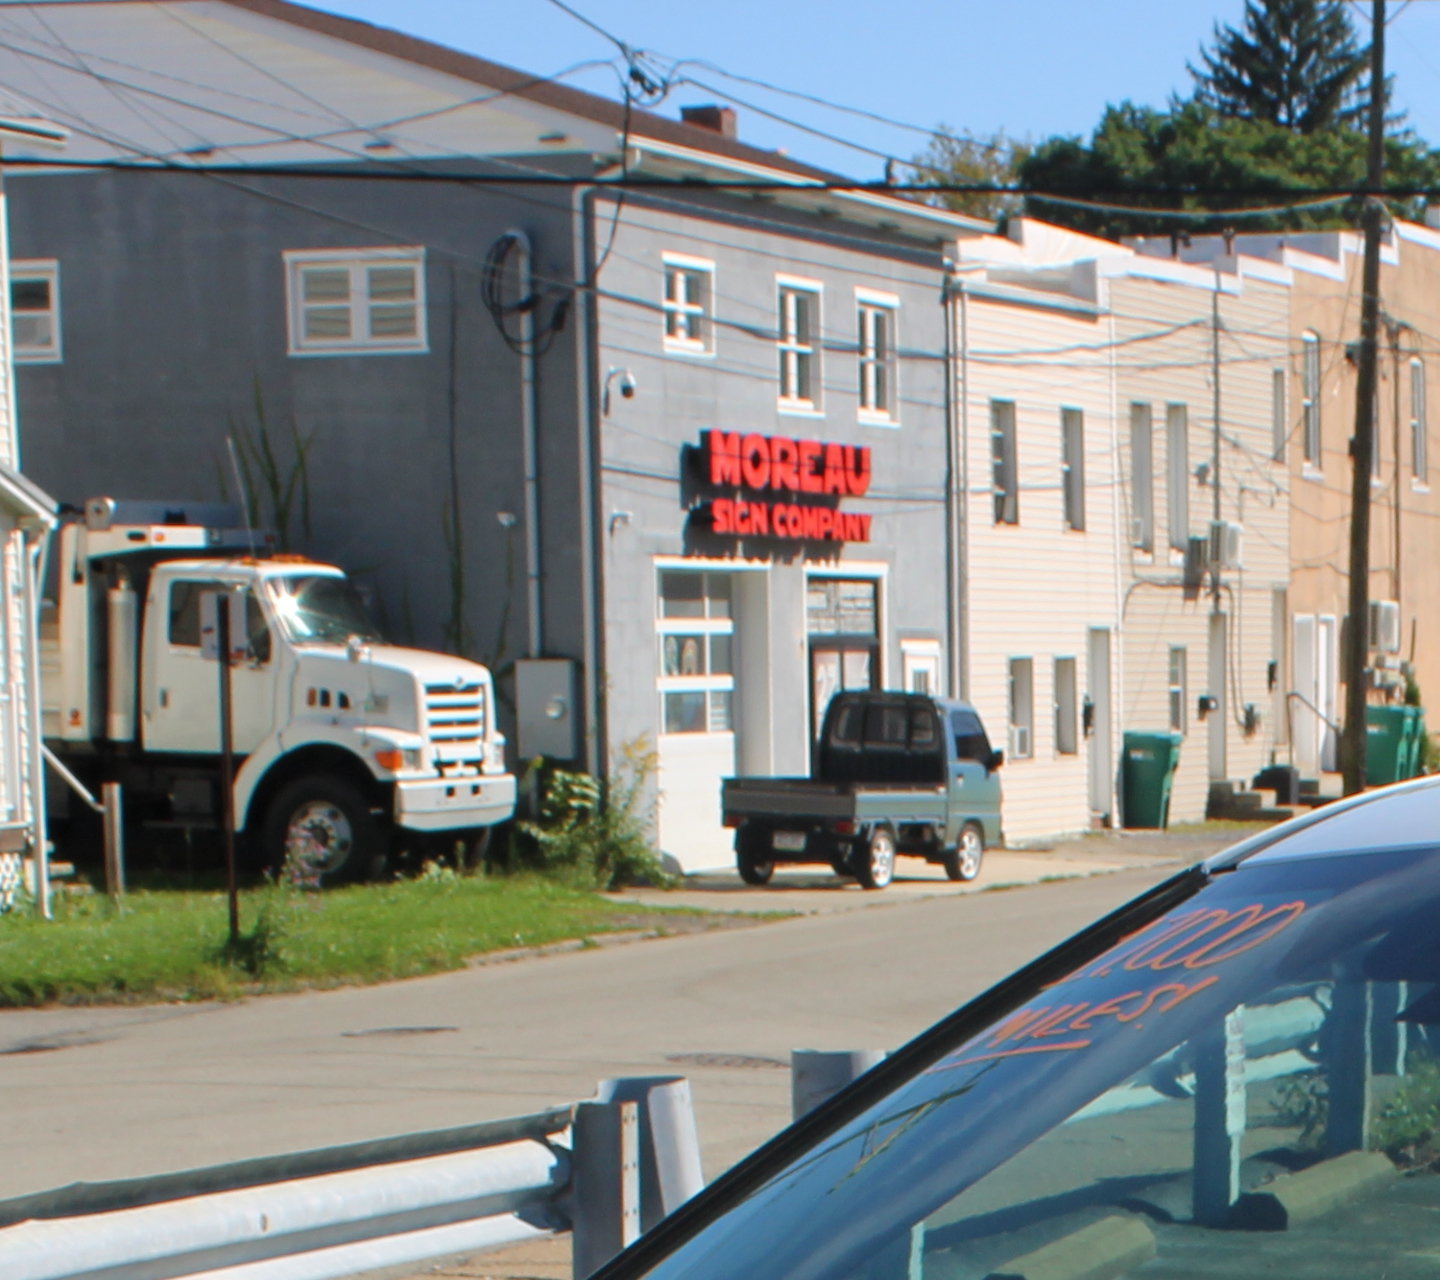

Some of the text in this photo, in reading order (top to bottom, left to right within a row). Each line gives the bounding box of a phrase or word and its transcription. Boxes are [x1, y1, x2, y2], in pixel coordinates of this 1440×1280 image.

[709, 430, 872, 496] MOREAU
[712, 498, 872, 542] SIGN COMPANY
